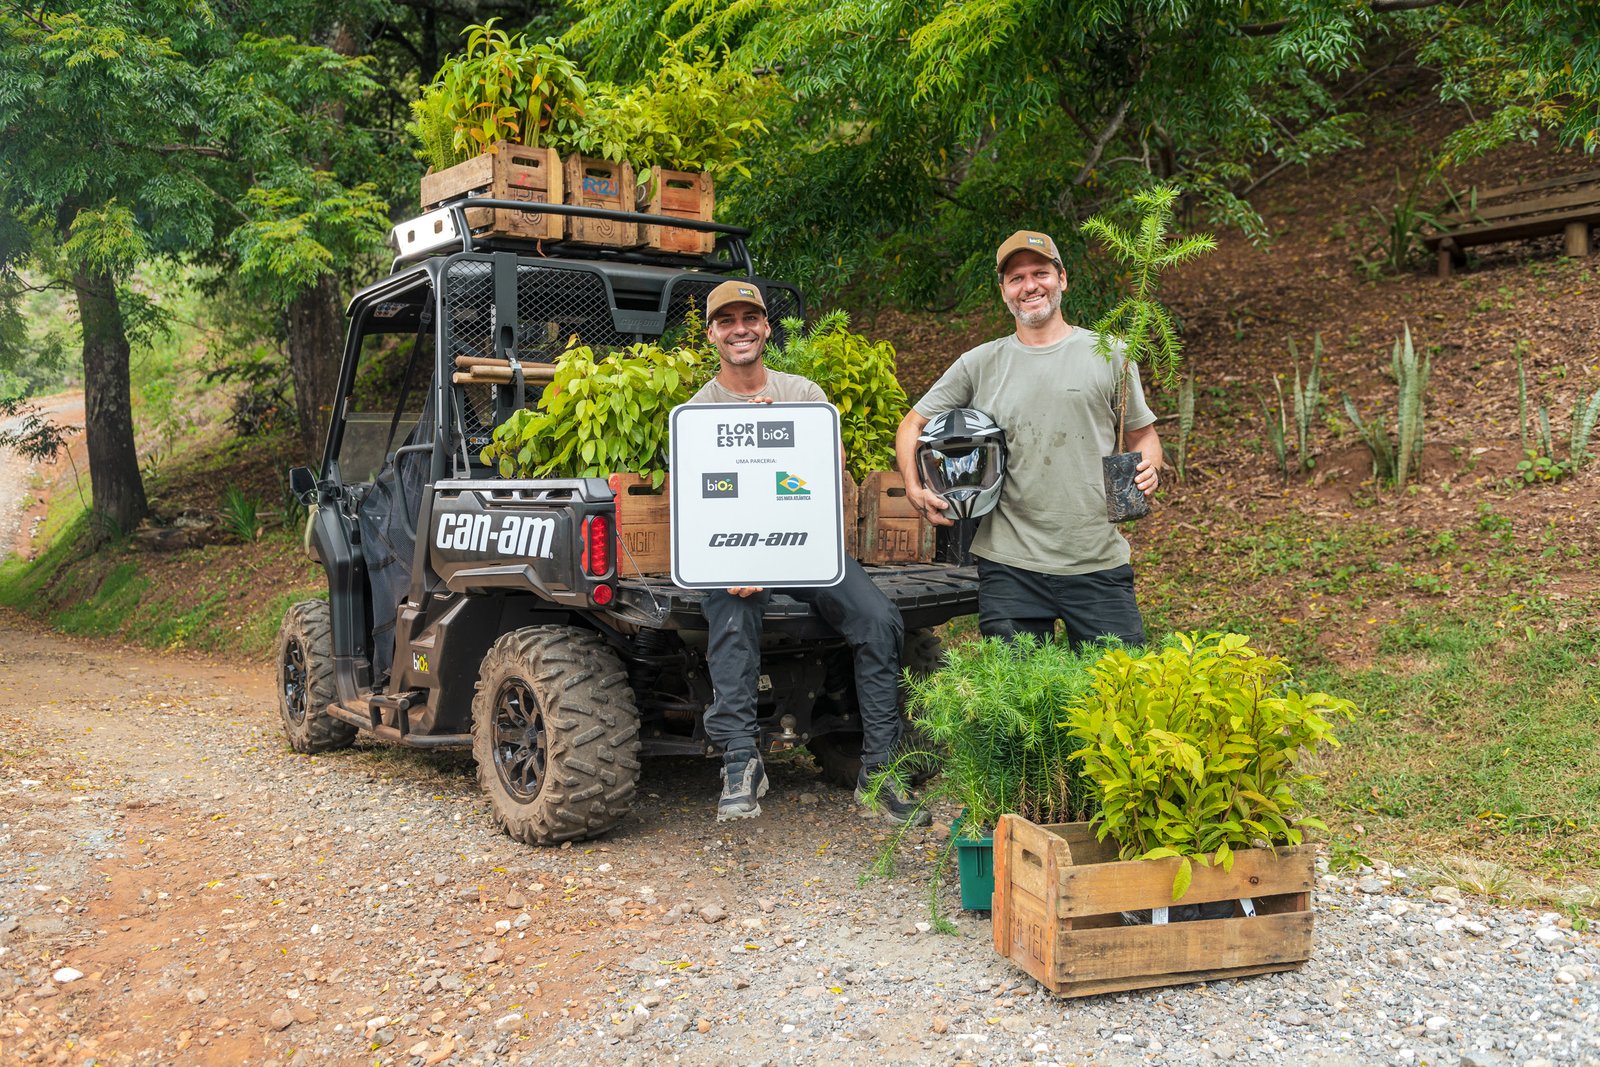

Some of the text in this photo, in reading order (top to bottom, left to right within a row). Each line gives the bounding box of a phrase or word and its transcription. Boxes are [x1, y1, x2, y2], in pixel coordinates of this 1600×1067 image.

[717, 423, 755, 435] FLOR
[717, 436, 755, 447] ESTA
[436, 513, 555, 559] can-am
[708, 531, 808, 547] can-am
[878, 529, 912, 552] BETEL
